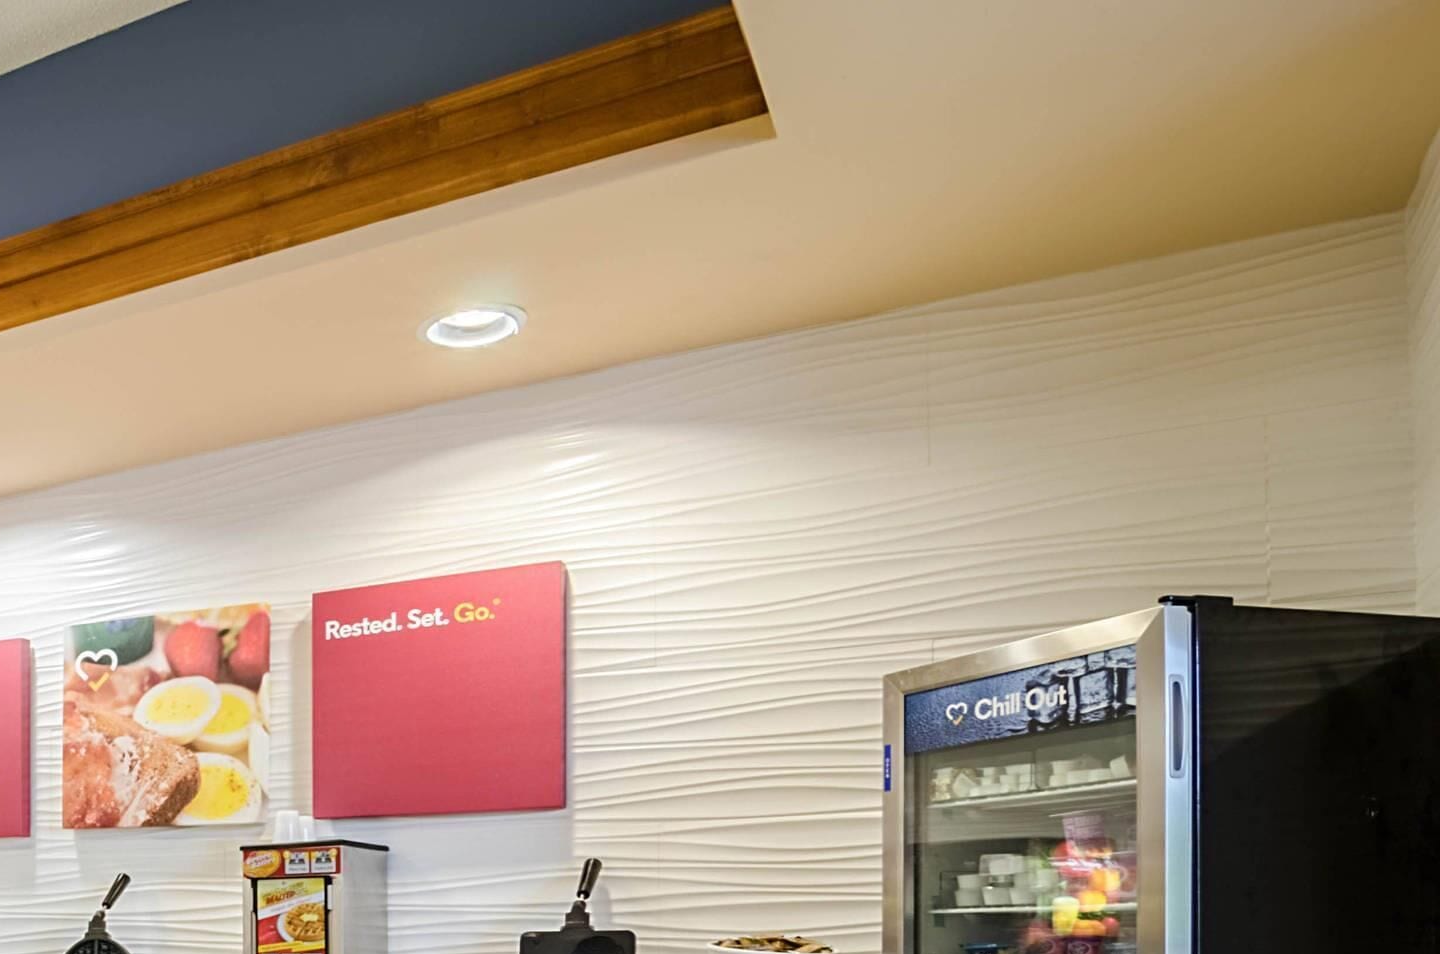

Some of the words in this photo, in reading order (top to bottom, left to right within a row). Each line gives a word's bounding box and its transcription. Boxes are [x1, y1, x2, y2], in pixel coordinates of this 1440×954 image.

[325, 612, 403, 640] Rested.
[407, 608, 450, 629] Set.
[974, 692, 1020, 720] Chill
[1025, 685, 1067, 711] Out
